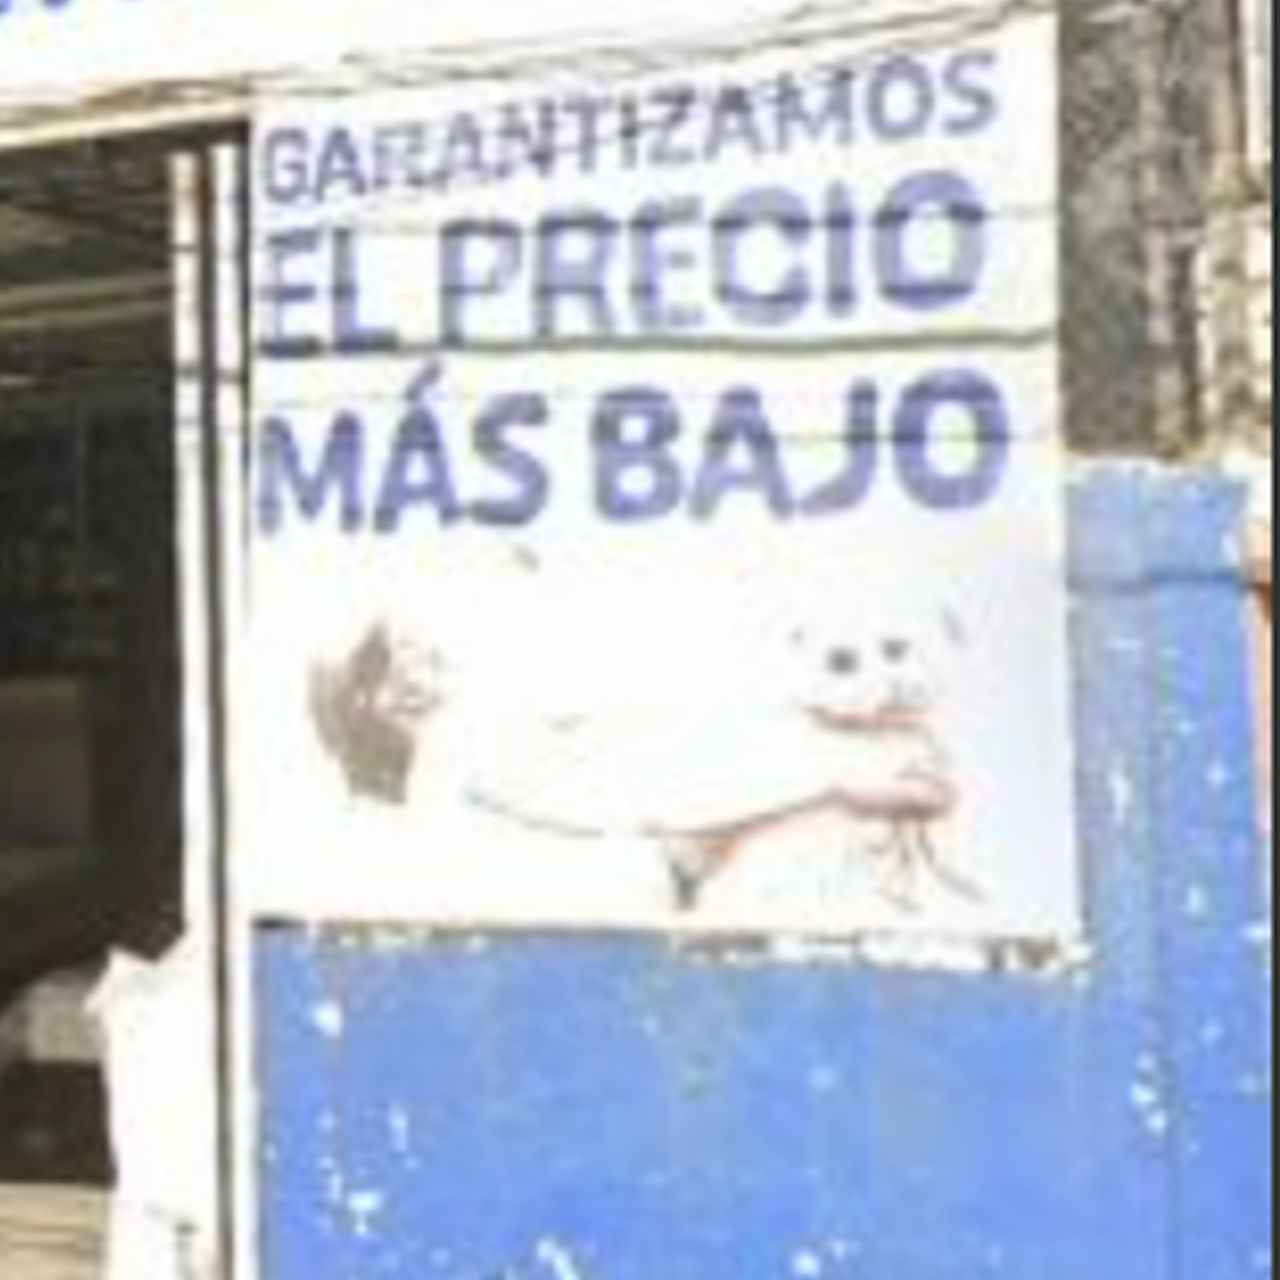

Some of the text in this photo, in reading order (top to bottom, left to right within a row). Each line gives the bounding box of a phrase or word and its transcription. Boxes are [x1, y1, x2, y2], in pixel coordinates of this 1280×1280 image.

[262, 50, 998, 204] GARANTIZAMOS
[258, 168, 986, 358] EL PRECIO
[258, 360, 1010, 534] MÁS BAJO
